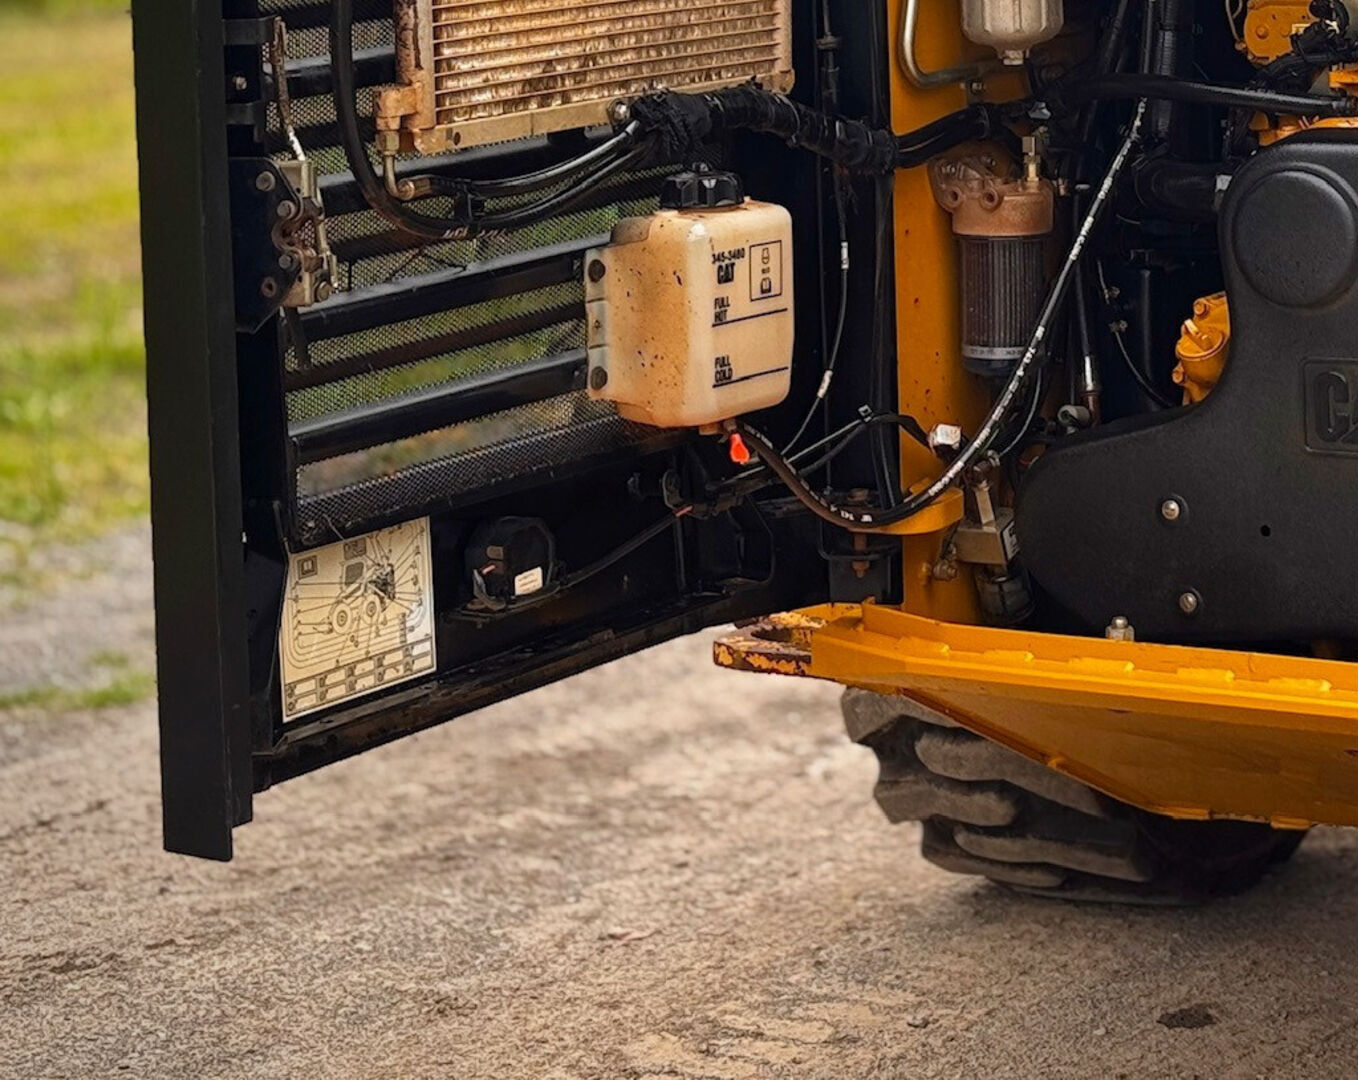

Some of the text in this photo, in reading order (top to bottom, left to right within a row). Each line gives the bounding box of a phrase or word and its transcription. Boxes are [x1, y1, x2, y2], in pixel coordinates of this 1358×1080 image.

[717, 263, 736, 285] CAT
[714, 296, 730, 309] FULL
[714, 309, 728, 322] HOT
[714, 355, 730, 368] FULL
[714, 368, 733, 383] COLD
